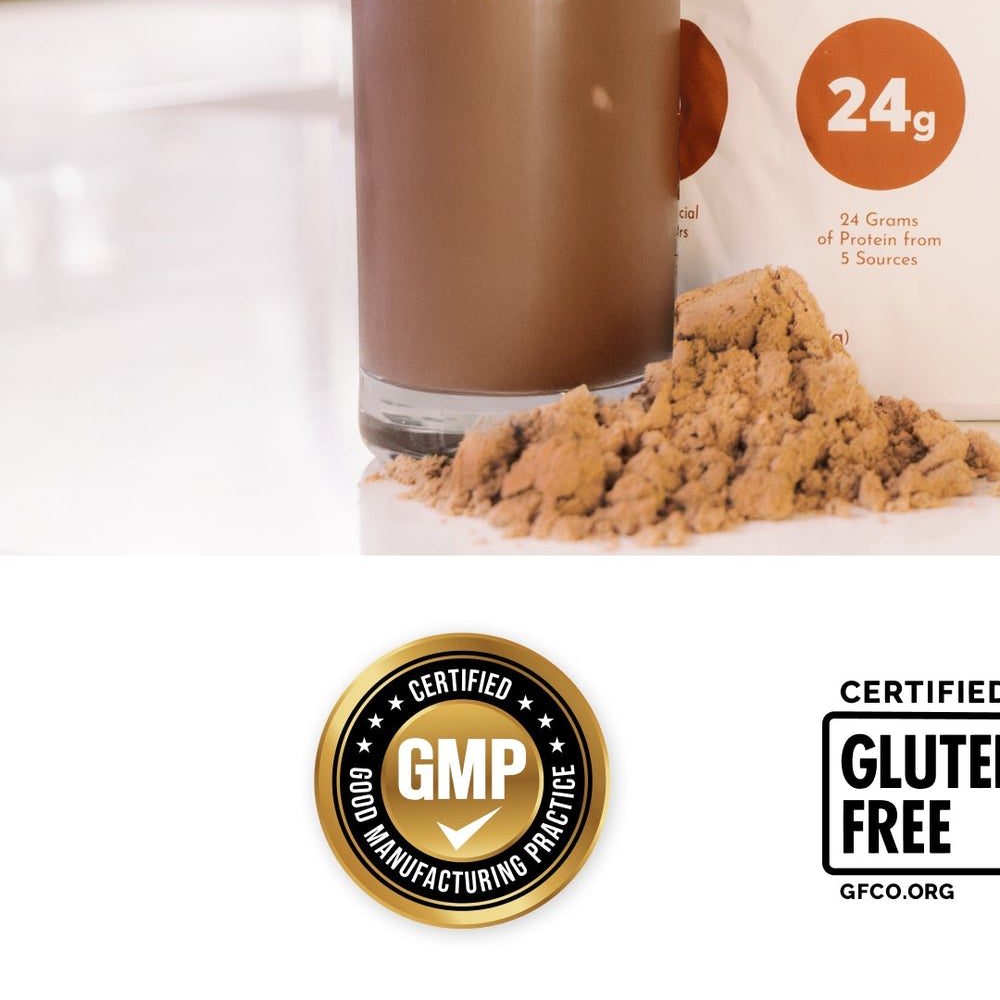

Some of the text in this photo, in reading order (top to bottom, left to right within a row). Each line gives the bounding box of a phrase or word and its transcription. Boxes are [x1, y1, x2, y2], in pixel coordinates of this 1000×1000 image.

[828, 77, 935, 141] 24g
[840, 212, 918, 228] 24 Grams
[818, 230, 941, 246] of Protein from
[841, 250, 917, 265] 5 Sources
